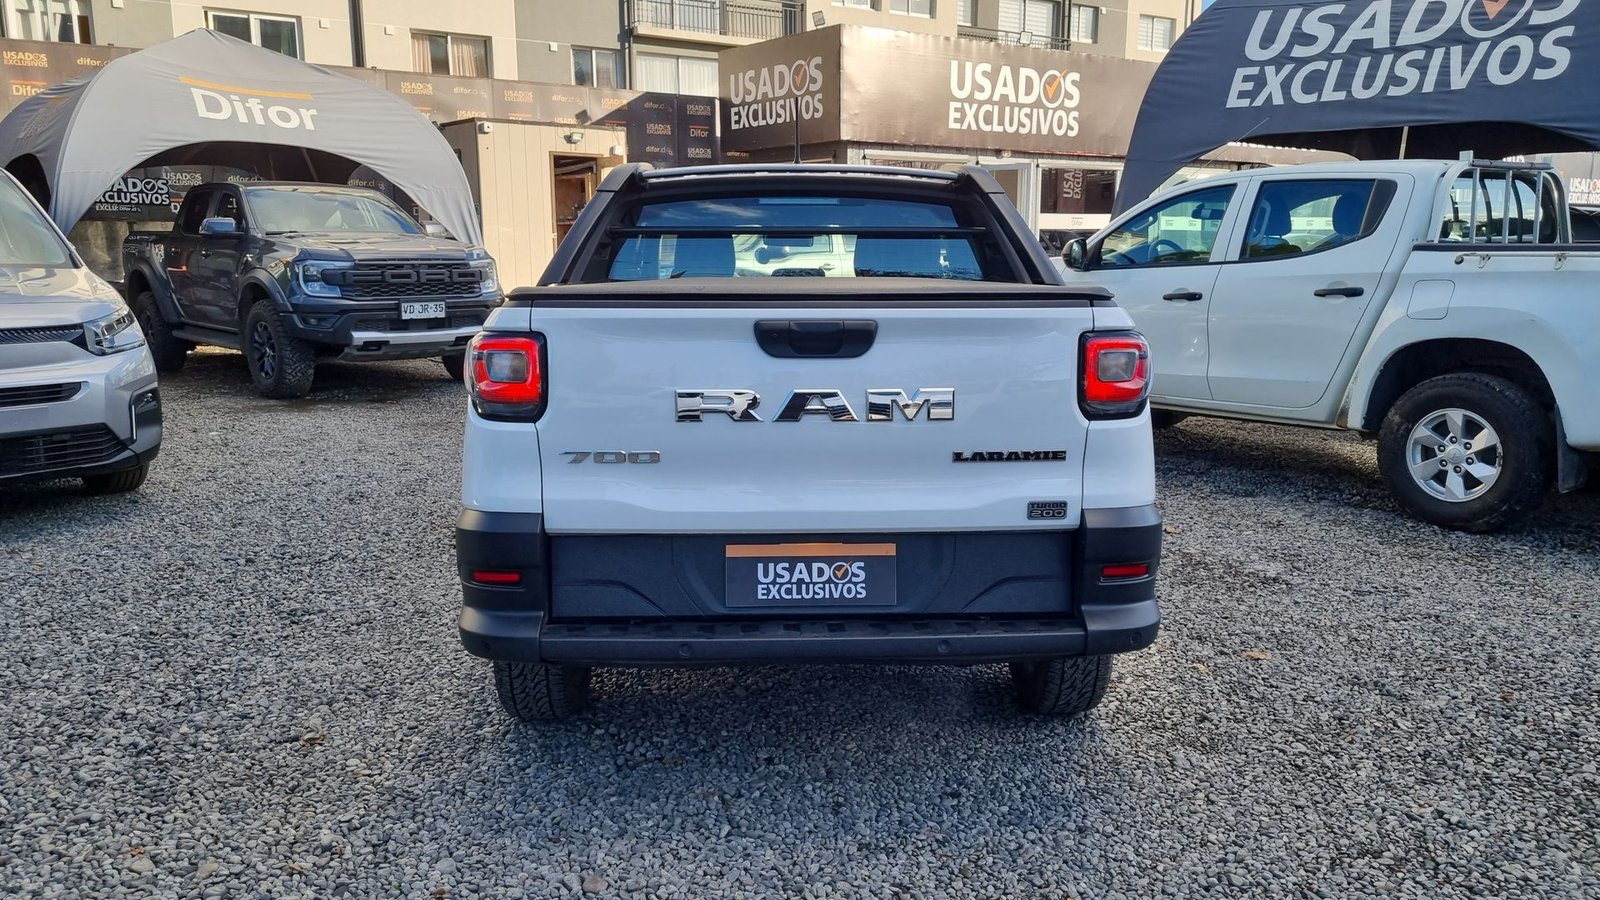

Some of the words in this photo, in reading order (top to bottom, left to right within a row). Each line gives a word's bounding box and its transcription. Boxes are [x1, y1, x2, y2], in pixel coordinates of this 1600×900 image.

[3, 50, 47, 62] USADOS
[3, 59, 48, 68] EXCLUSIVOS
[1225, 25, 1578, 109] EXCLUSIVOS
[400, 81, 433, 90] USADOS
[730, 56, 823, 105] USADOS
[950, 60, 1080, 109] USADOS
[504, 89, 533, 99] USADOS
[190, 87, 318, 131] Difor
[730, 93, 824, 130] EXCLUSIVOS
[645, 123, 673, 131] USADOS
[948, 101, 1080, 138] EXCLUSIVOS
[689, 128, 710, 138] Difor
[686, 146, 713, 155] USADOS
[341, 269, 482, 284] FORD
[674, 388, 957, 422] RAM
[560, 450, 662, 465] 700
[951, 449, 1067, 463] LARAMIE
[1030, 501, 1068, 509] TURBO
[1031, 509, 1066, 518] 200
[757, 560, 866, 584] USADOS
[757, 582, 867, 600] EXCLUSIVOS
